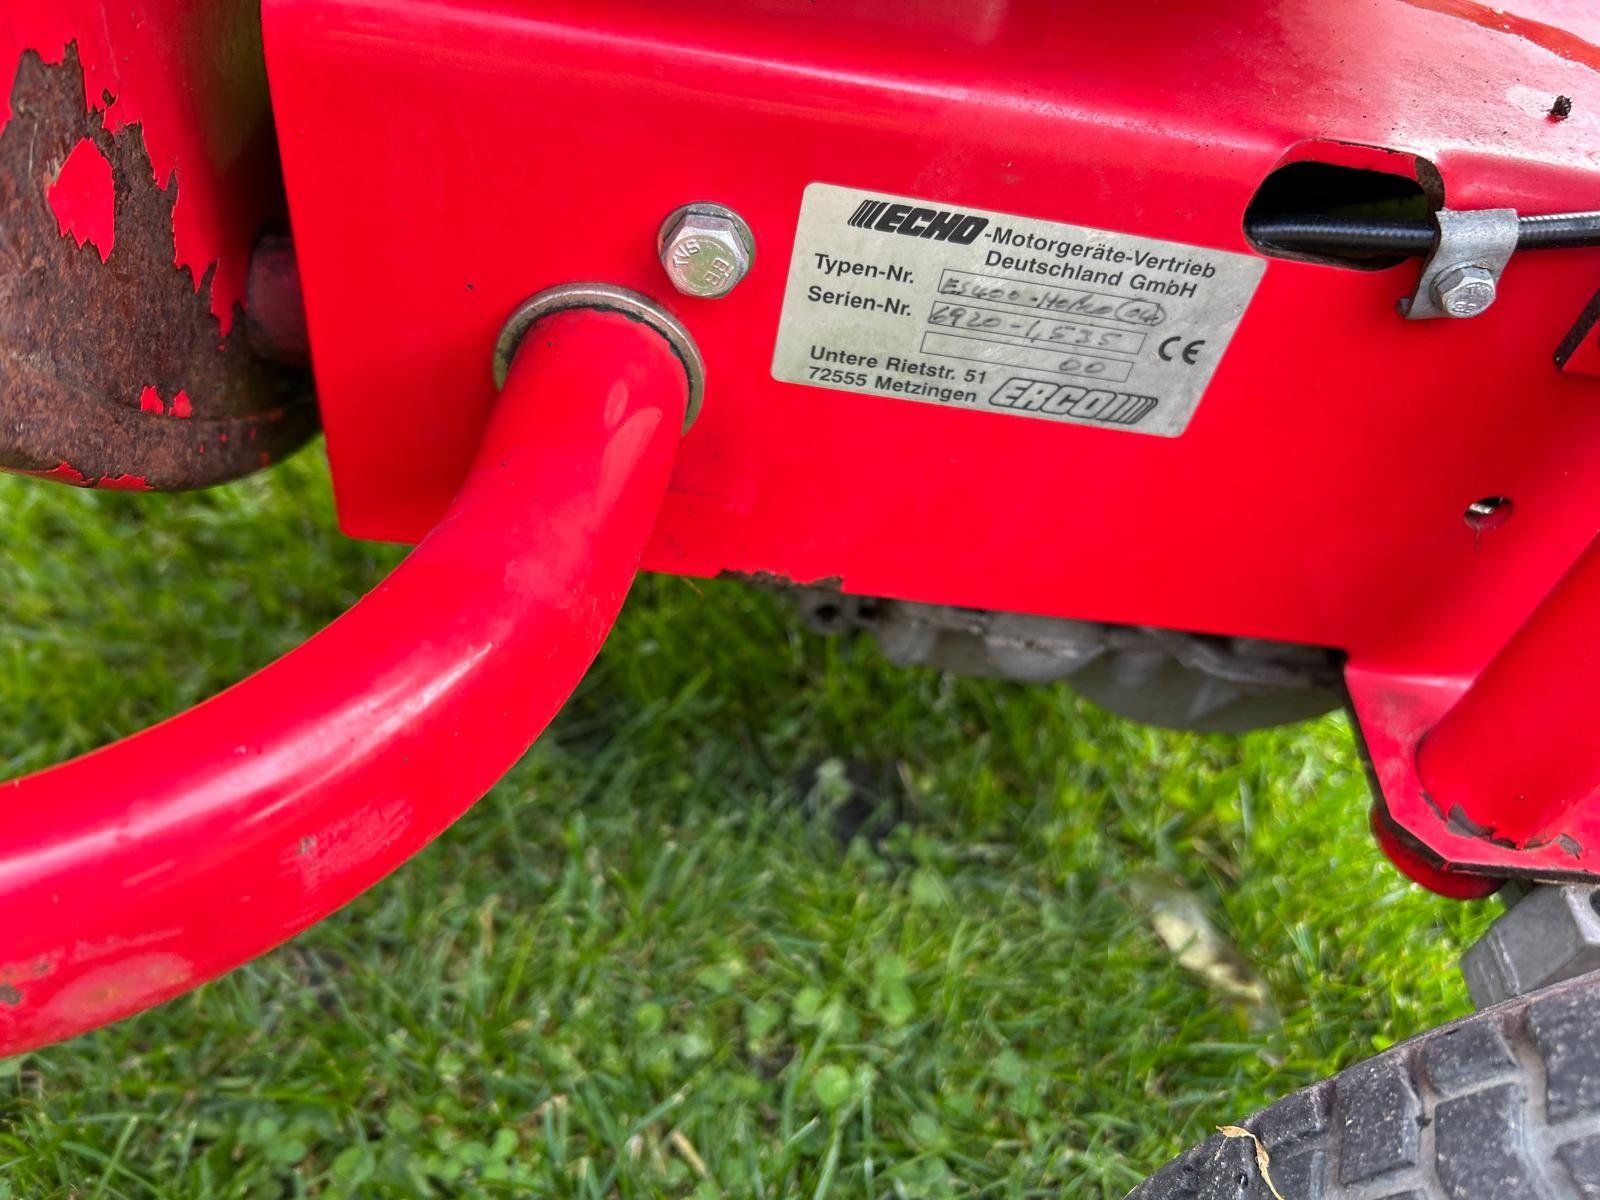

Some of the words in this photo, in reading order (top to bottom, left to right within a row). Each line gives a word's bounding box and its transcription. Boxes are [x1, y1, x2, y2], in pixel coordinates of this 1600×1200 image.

[872, 203, 990, 246] ECHO
[984, 226, 1217, 279] -Motorgeräte-Vertrieb
[813, 252, 915, 285] Typen-Nr.
[985, 250, 1123, 287] Deutschland
[1129, 274, 1198, 299] GmbH
[807, 285, 912, 317] Serien-Nr.
[810, 345, 878, 369] Untere
[885, 356, 957, 381] Rietstr.
[963, 370, 987, 385] 51
[1157, 335, 1206, 366] CE
[808, 365, 867, 387] 72555
[874, 375, 978, 403] Metzingen
[989, 376, 1119, 423] ERCO
